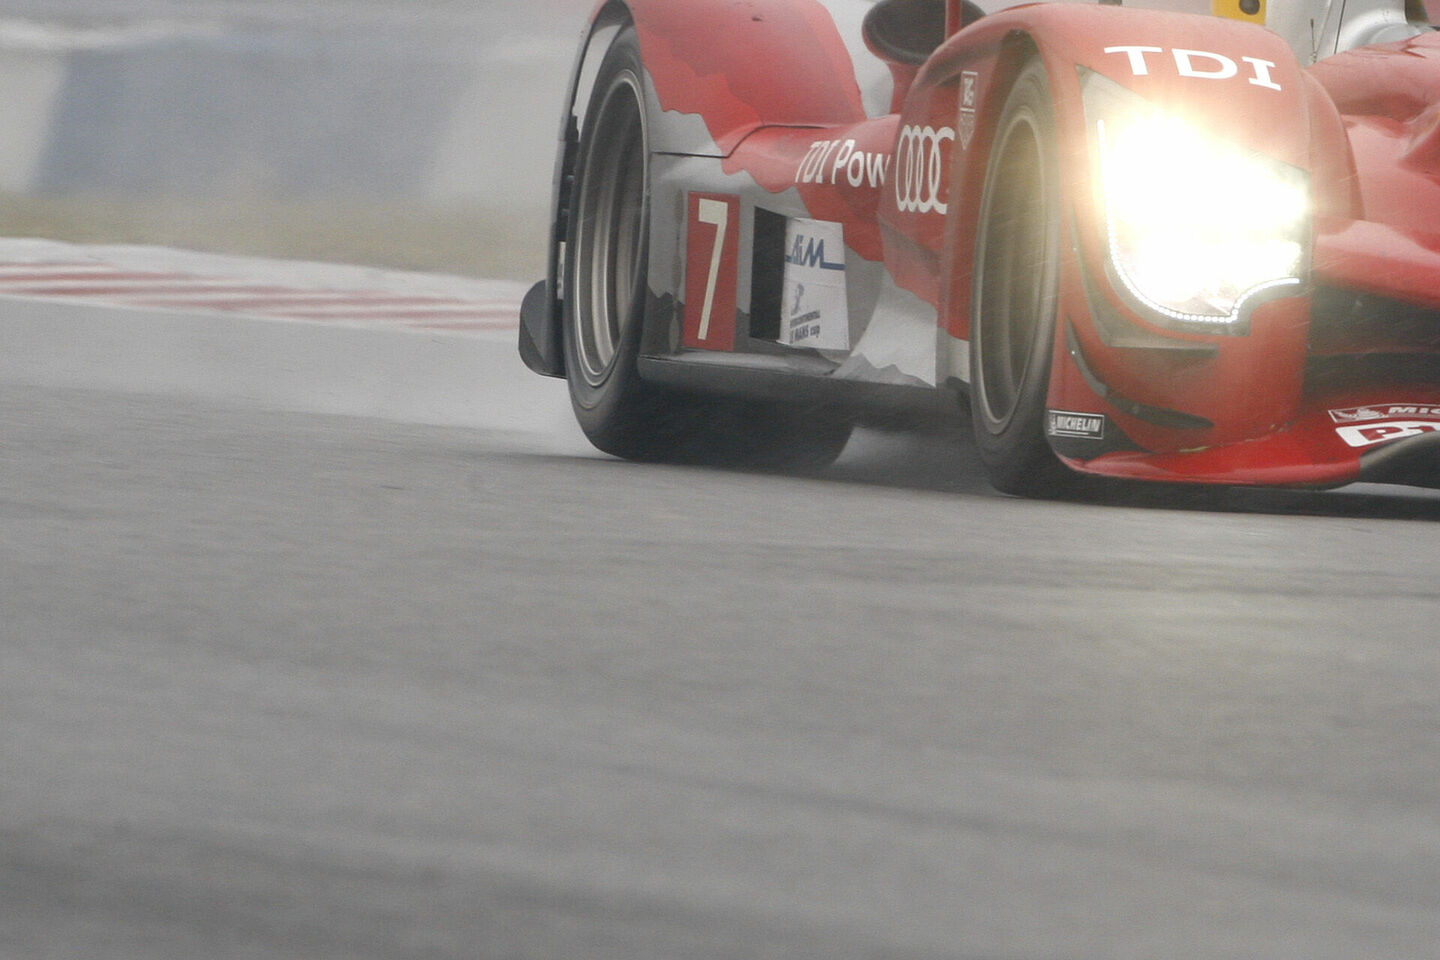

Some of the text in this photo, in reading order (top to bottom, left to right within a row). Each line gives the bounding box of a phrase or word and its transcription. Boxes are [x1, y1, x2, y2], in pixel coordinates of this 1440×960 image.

[1104, 46, 1282, 91] TDI
[795, 140, 840, 184] TDI
[697, 198, 729, 340] 7
[1056, 415, 1101, 432] MICHELIN
